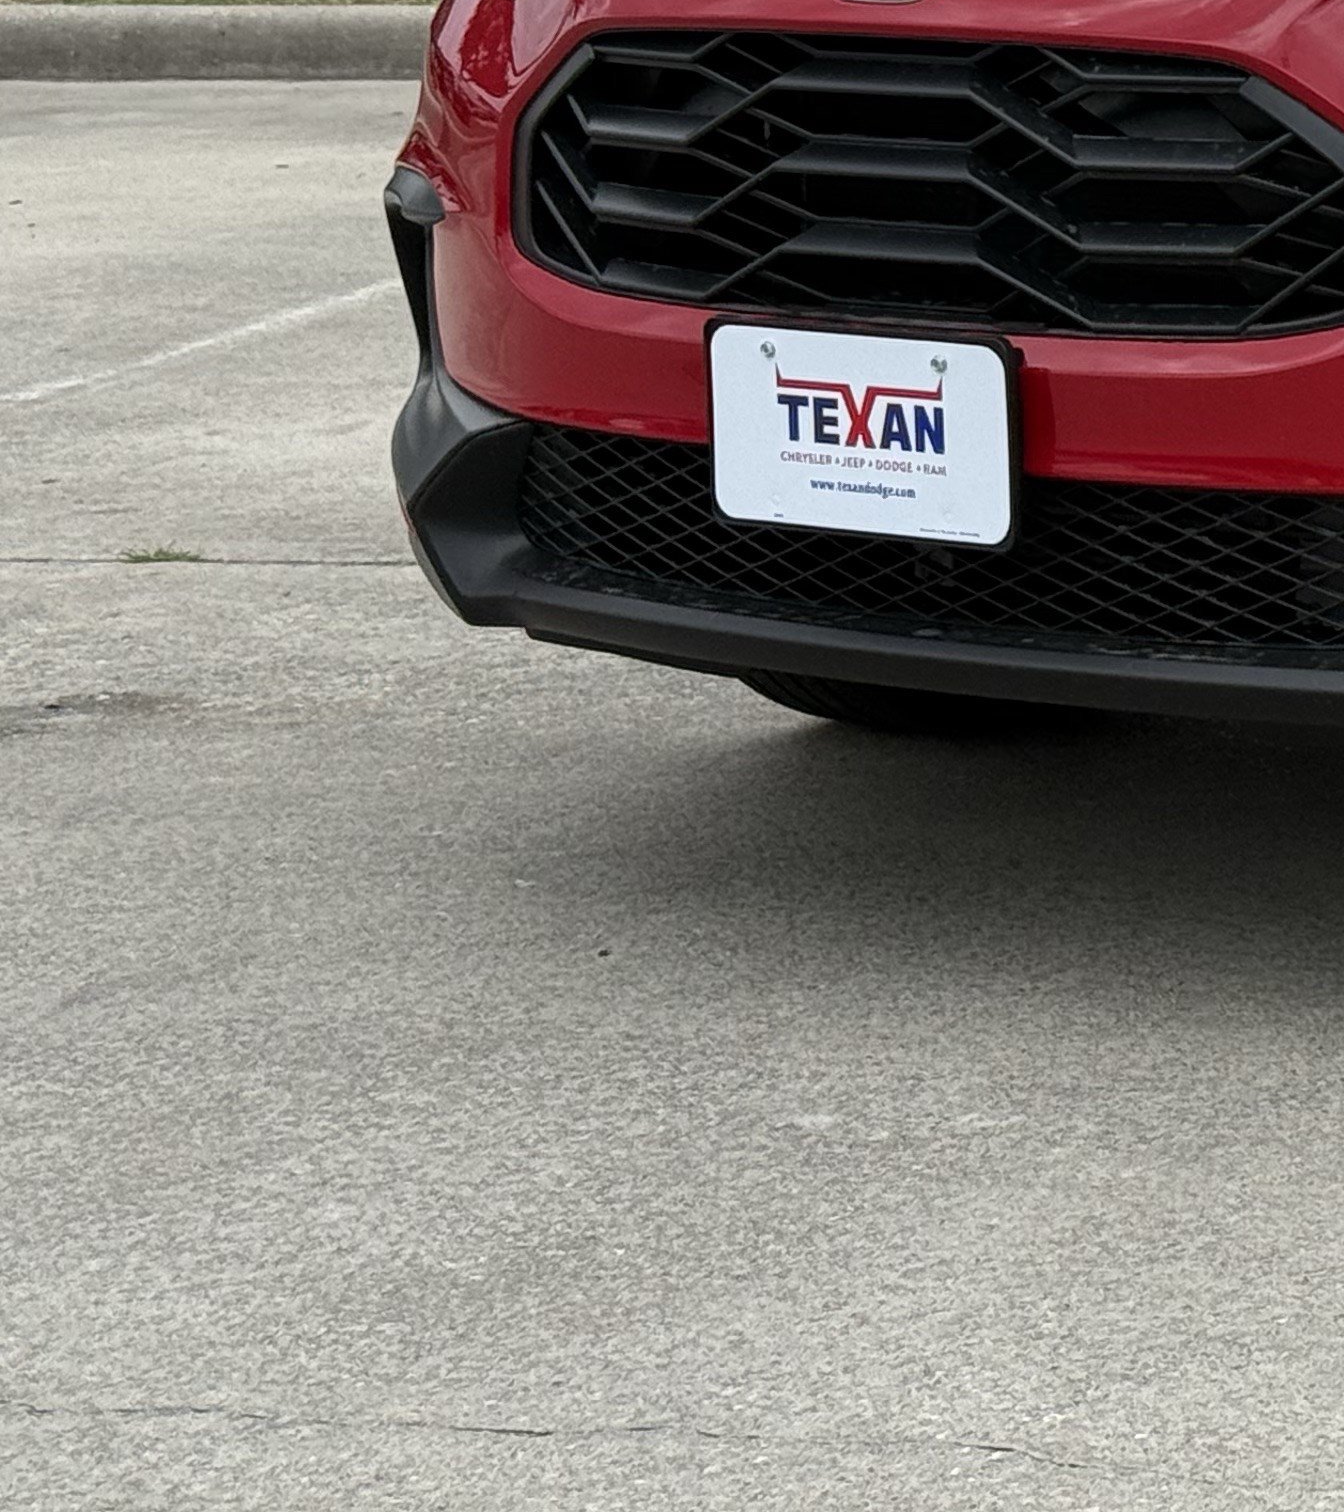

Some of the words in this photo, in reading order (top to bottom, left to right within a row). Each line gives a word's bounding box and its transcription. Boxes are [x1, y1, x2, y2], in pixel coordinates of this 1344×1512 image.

[775, 363, 945, 455] TEXAN
[780, 450, 832, 465] CHRYSLER
[841, 456, 865, 468] JEEP
[876, 459, 913, 473] DODGE
[923, 463, 947, 476] RAM
